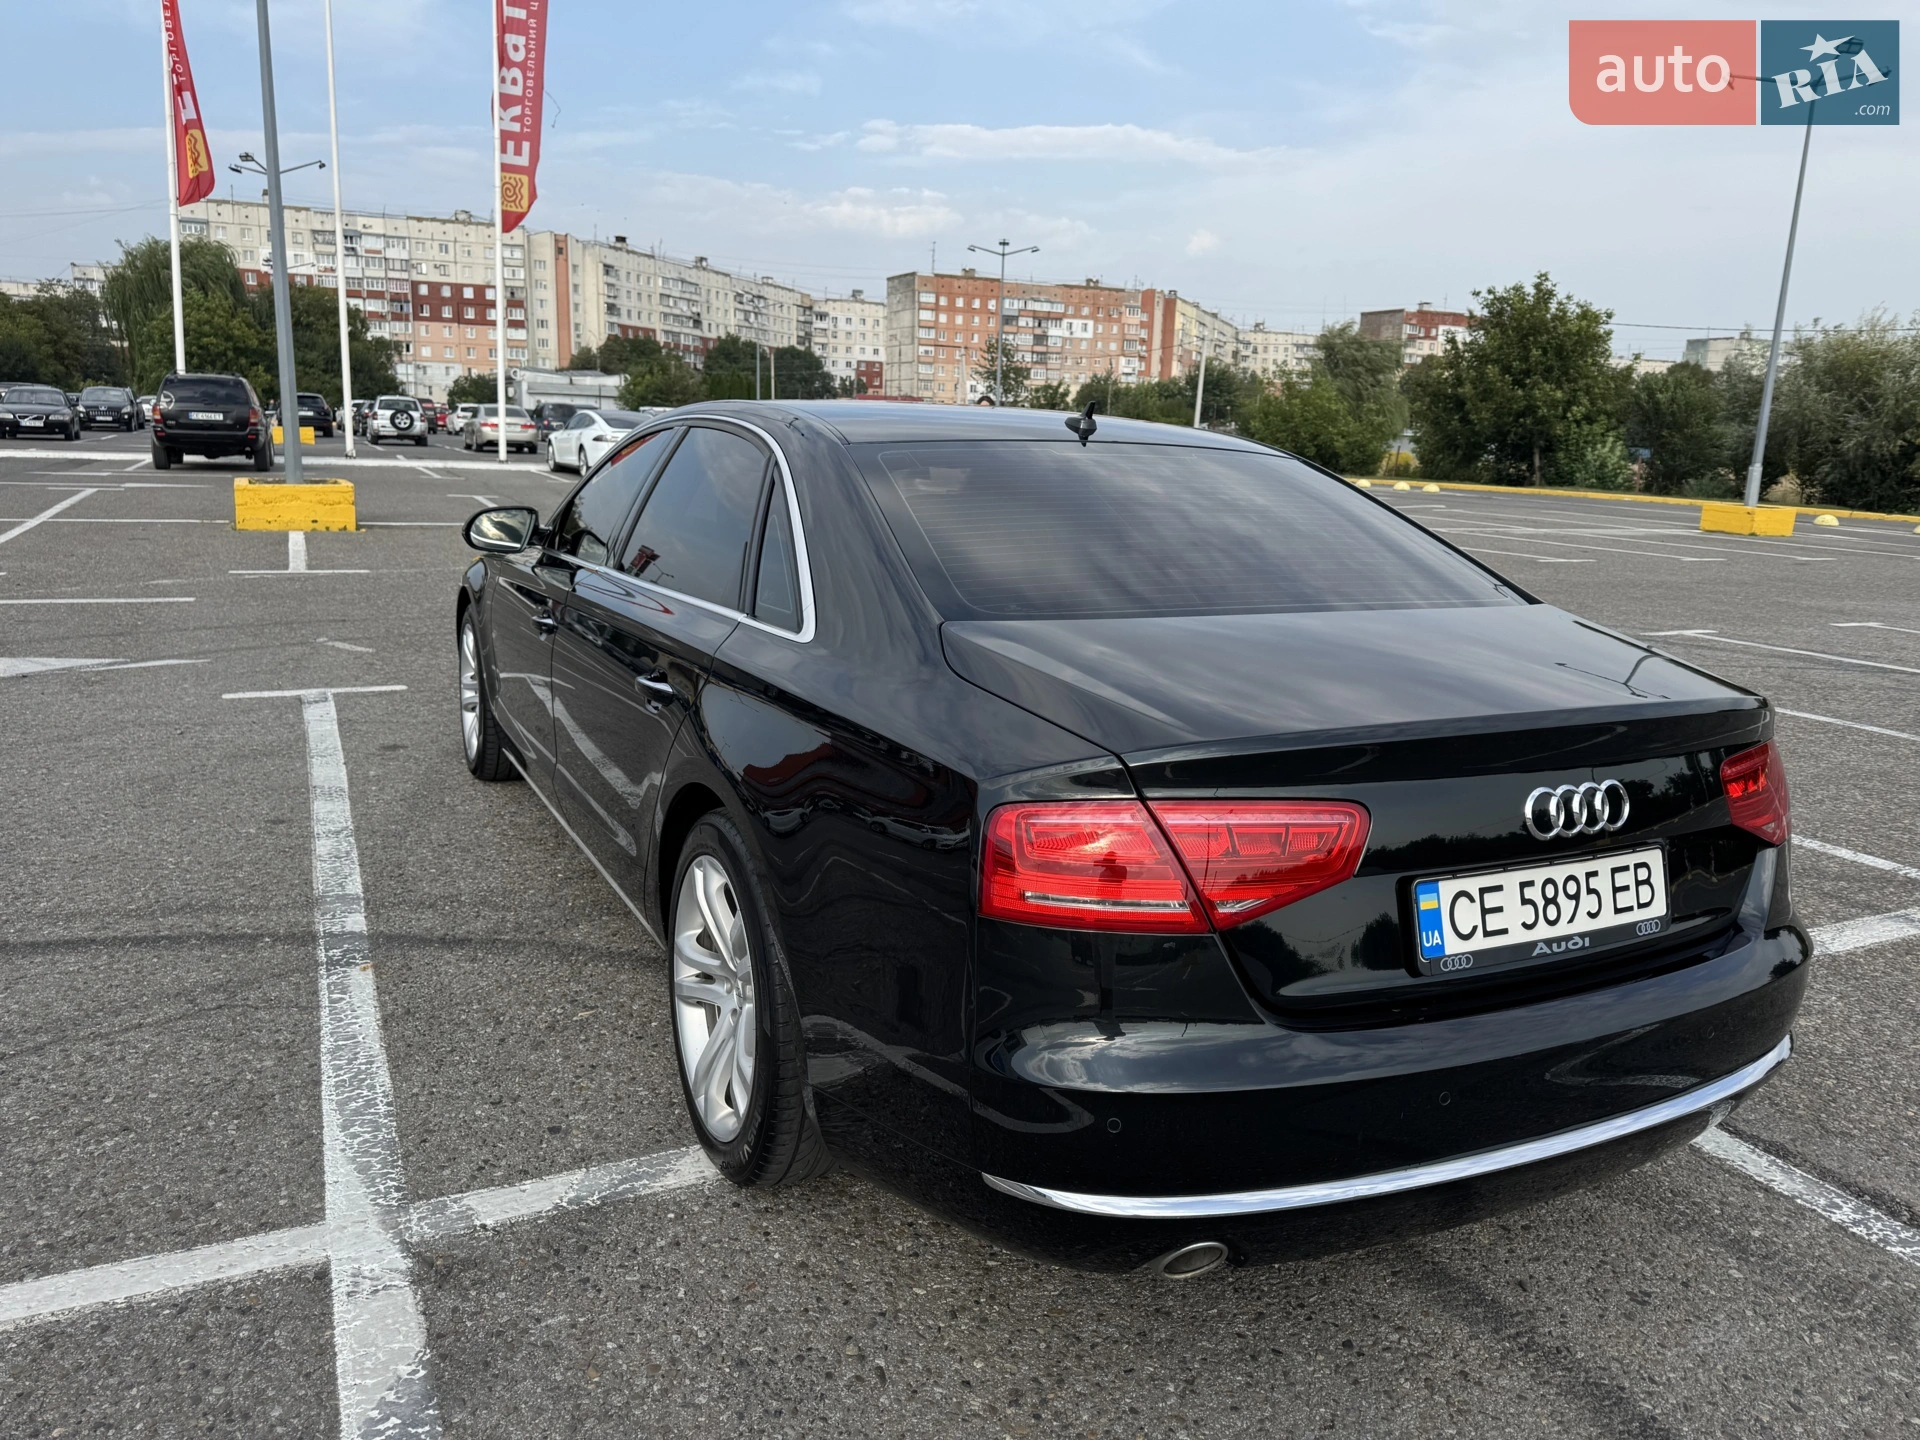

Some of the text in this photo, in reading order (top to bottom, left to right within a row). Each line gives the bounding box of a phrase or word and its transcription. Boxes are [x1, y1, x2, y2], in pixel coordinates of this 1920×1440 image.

[523, 18, 537, 133] ТОРГОВЕЛЬНИЙ
[1449, 861, 1655, 941] CE 5895 EB
[1423, 929, 1442, 948] UA
[1532, 936, 1590, 956] Audi
